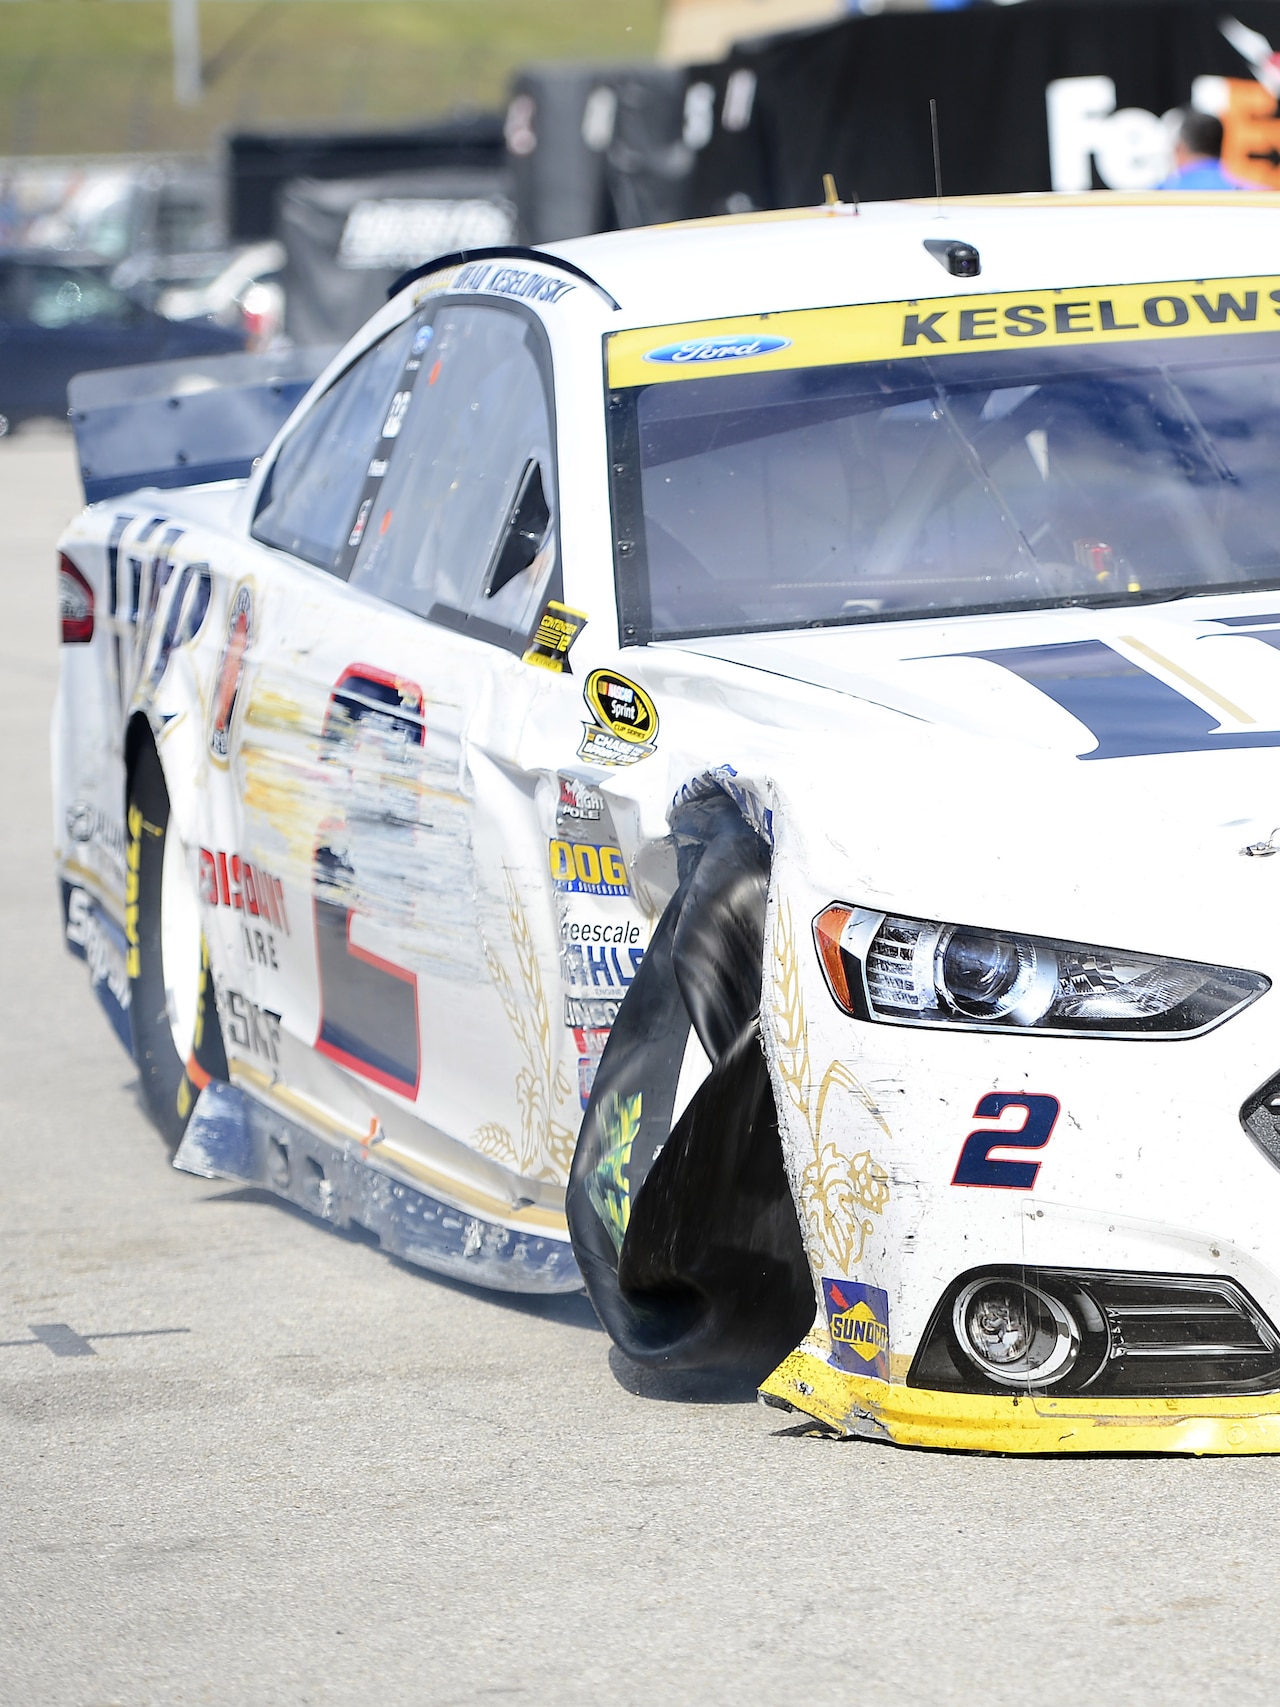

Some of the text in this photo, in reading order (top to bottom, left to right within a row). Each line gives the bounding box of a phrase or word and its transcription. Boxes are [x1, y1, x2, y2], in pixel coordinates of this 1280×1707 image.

[671, 338, 762, 364] Ford
[611, 700, 636, 720] Sprint
[613, 724, 646, 739] CUP SERIES
[594, 734, 635, 755] CHASE
[563, 805, 601, 820] POLE
[561, 921, 640, 944] eescale
[243, 926, 280, 971] IRE
[227, 990, 282, 1064] SKF
[950, 1091, 1061, 1191] 2
[833, 1316, 887, 1350] SUNOCO
